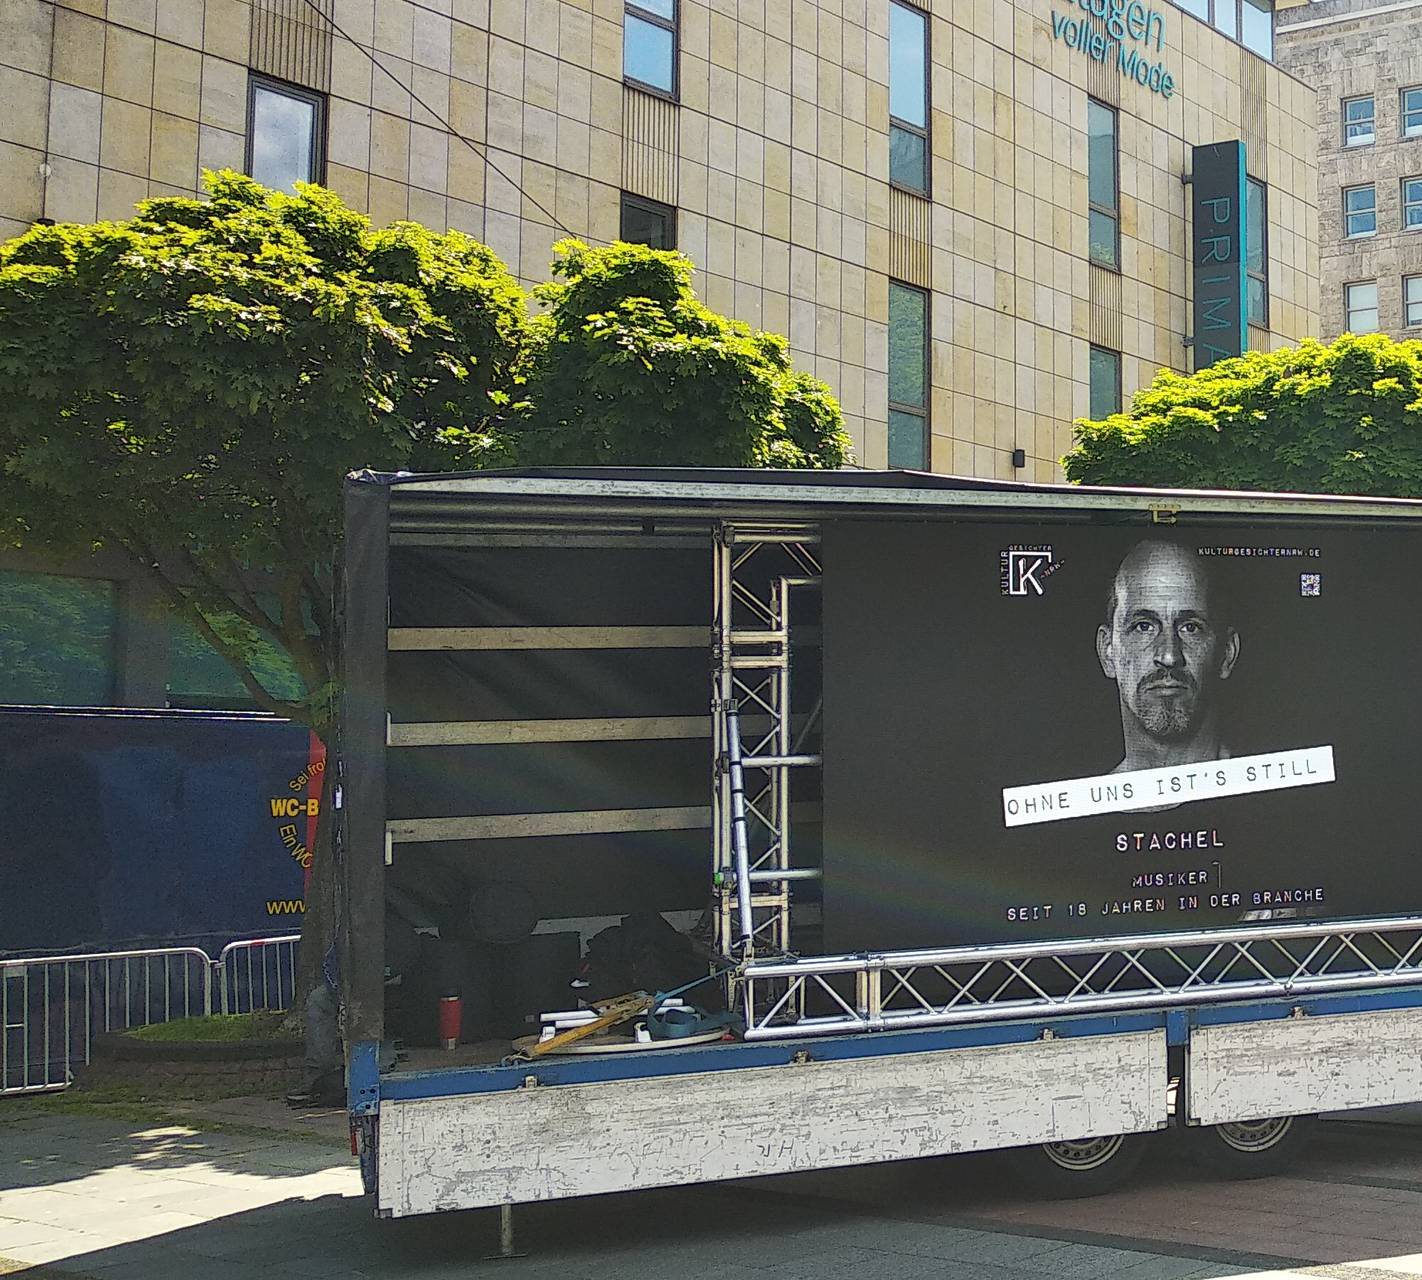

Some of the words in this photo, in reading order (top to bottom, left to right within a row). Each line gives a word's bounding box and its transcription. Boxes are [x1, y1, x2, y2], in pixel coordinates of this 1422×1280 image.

[1051, 10, 1115, 65] voller
[1116, 42, 1175, 99] Mode
[1000, 551, 1009, 595] KULTUR
[289, 770, 309, 792] Sei
[306, 757, 327, 777] fro
[1006, 791, 1071, 816] OHNE
[1090, 782, 1135, 803] UNS
[1156, 770, 1228, 796] IST'S
[1245, 759, 1318, 782] STILL
[270, 798, 320, 817] WC-B
[279, 823, 297, 849] Ein
[1116, 830, 1224, 851] STACHEL
[1132, 870, 1208, 888] MUSIKER
[1007, 904, 1052, 921] SEIT
[1067, 903, 1088, 917] 18
[1101, 899, 1166, 916] JAHREN
[1179, 896, 1199, 910] IN
[1209, 893, 1241, 907] DER
[1252, 887, 1324, 905] BRANCHE
